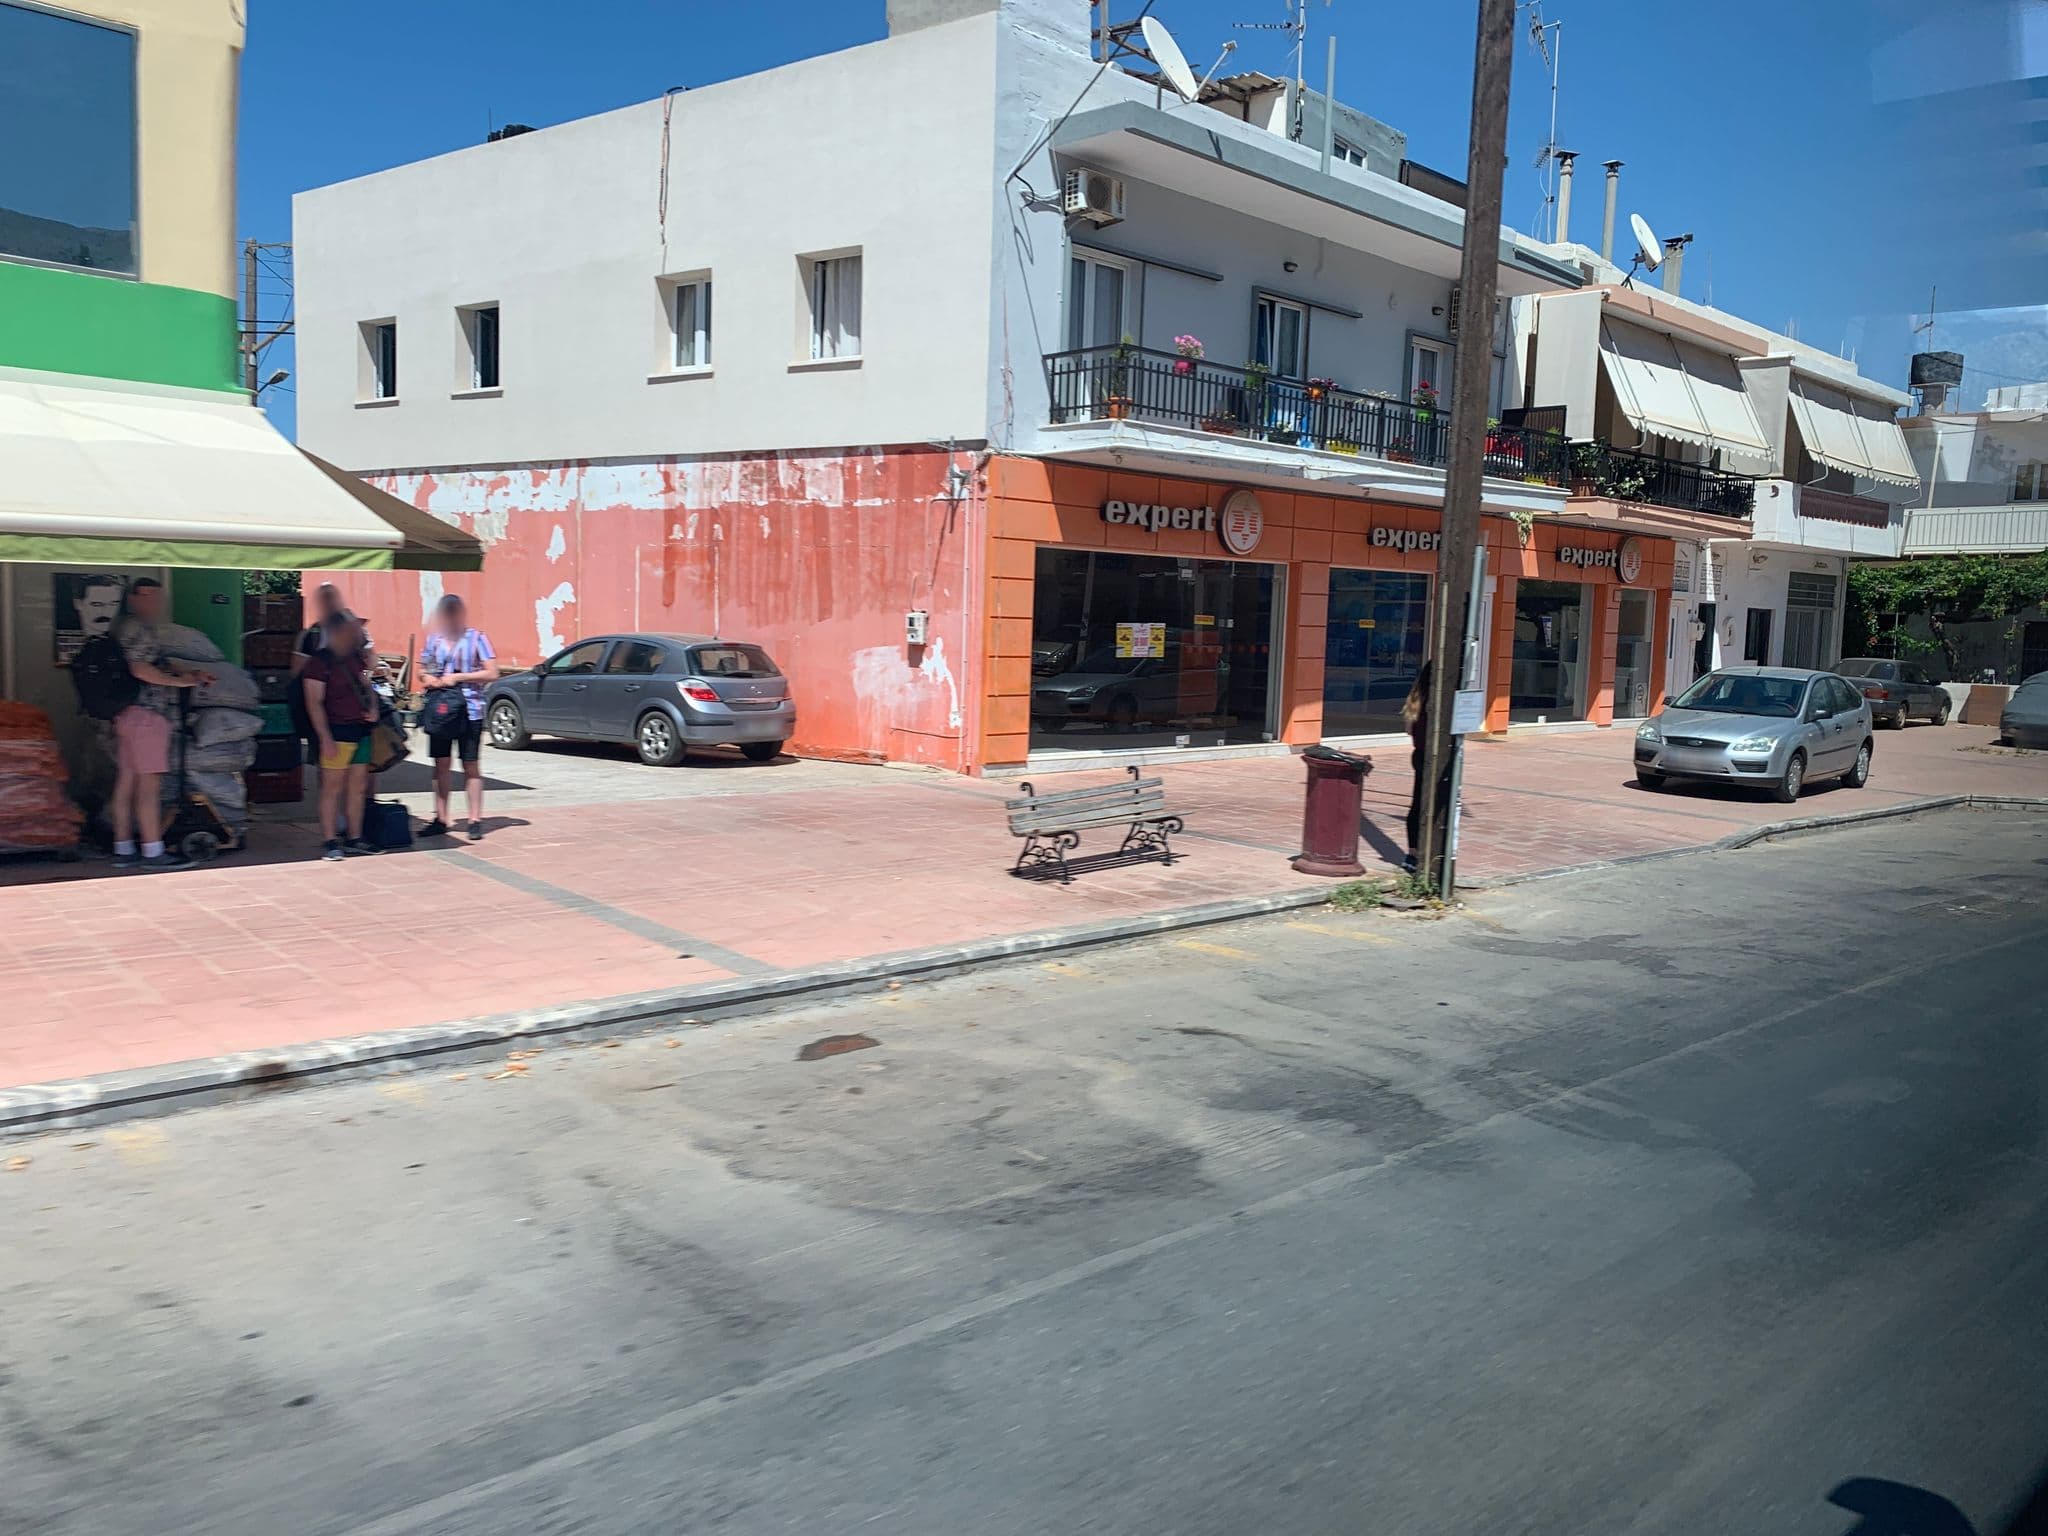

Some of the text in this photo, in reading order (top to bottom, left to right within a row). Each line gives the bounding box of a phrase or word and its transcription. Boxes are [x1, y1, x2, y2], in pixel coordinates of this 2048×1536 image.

[1105, 500, 1216, 532] expert
[1372, 527, 1441, 553] exper
[1561, 546, 1618, 569] expert
